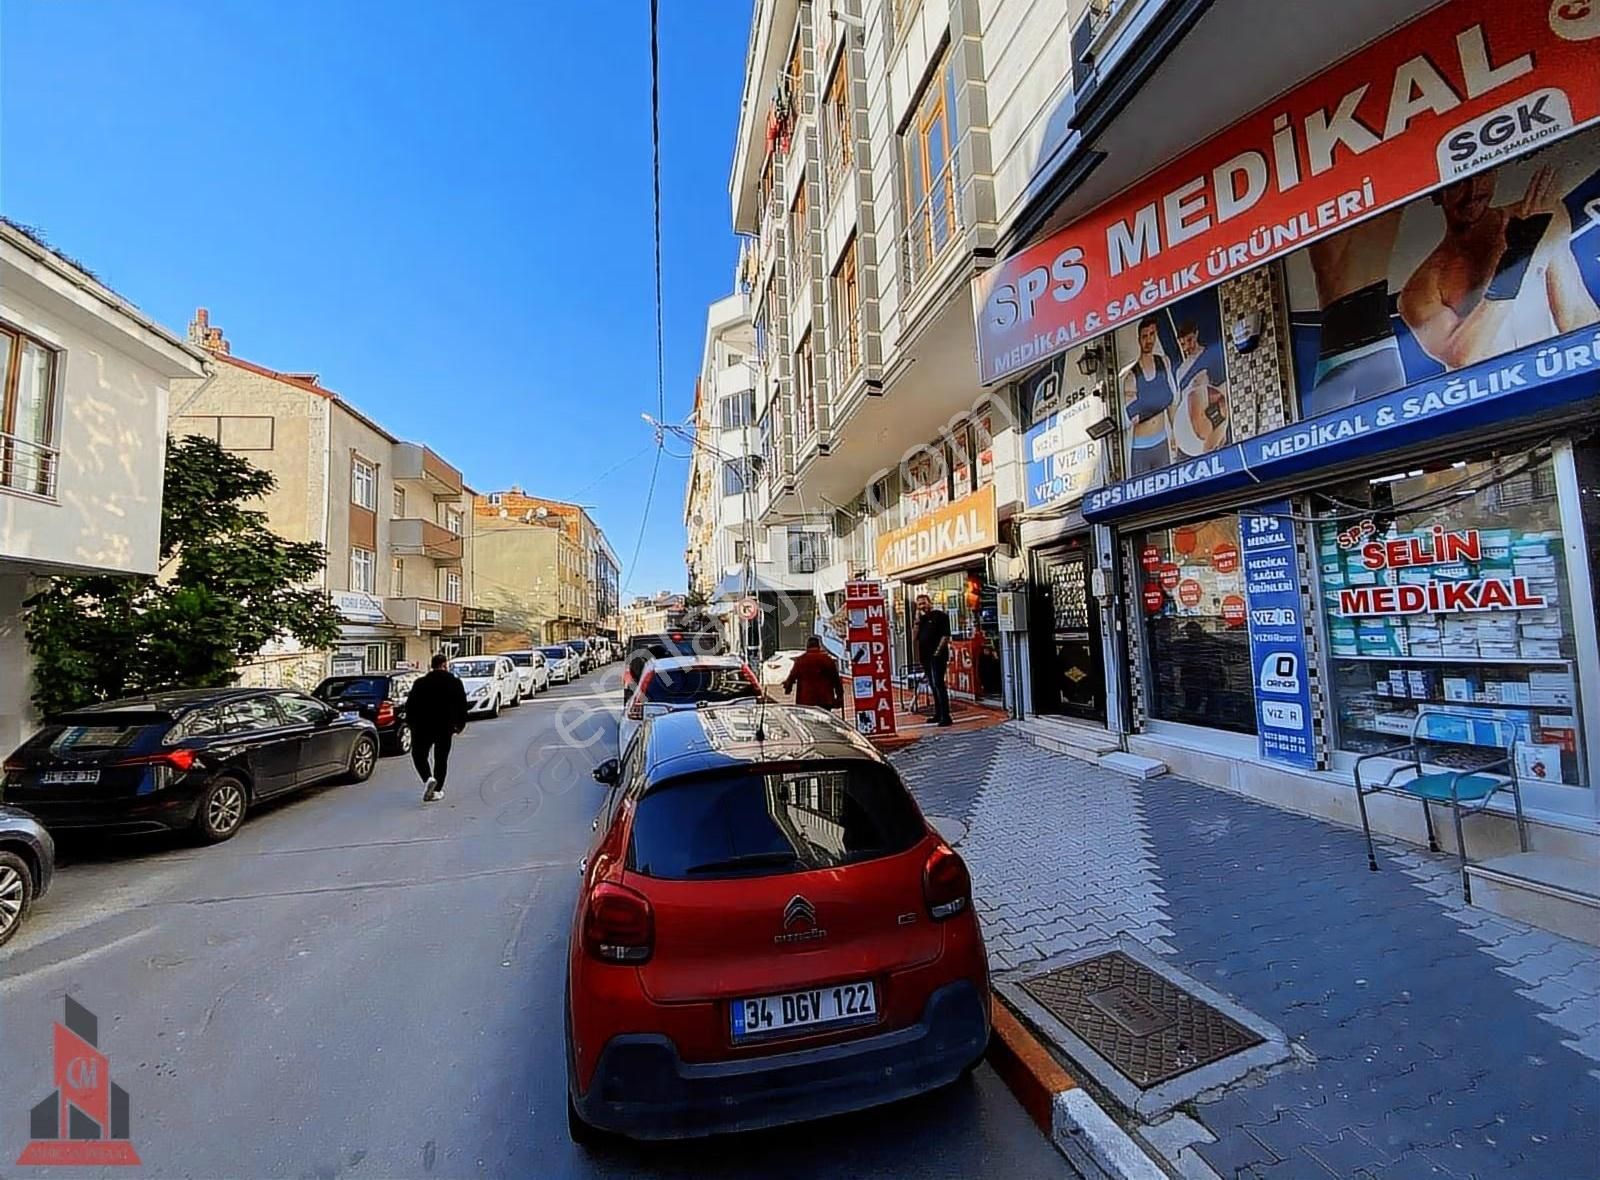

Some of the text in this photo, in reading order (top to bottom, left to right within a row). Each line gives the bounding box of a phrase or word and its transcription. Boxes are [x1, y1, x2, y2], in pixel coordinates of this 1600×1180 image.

[1449, 94, 1556, 161] SGK
[988, 25, 1533, 333] SPS MEDİKAL
[993, 177, 1375, 372] MEDİKAL & SAĞLIK ÜRÜNLERİ
[1066, 386, 1086, 409] SPS
[1261, 416, 1369, 461] MEDİKAL
[1376, 406, 1396, 427] &
[1402, 362, 1526, 419] SAĞLIK
[1091, 486, 1122, 510] SPS
[1126, 456, 1225, 499] MEDİKAL
[893, 510, 986, 567] MEDİKAL
[1246, 532, 1287, 547] MEDİKAL
[1250, 516, 1280, 534] SPS
[1337, 518, 1377, 549] SPS
[1248, 556, 1289, 570] MEDİKAL
[1361, 524, 1482, 572] SELİN
[847, 583, 880, 598] EFE
[1248, 579, 1294, 594] ÜRÜNLERİ
[1338, 576, 1549, 618] MEDİKAL
[866, 604, 892, 732] MEDİKAL
[745, 985, 872, 1030] 34 DGV 122
